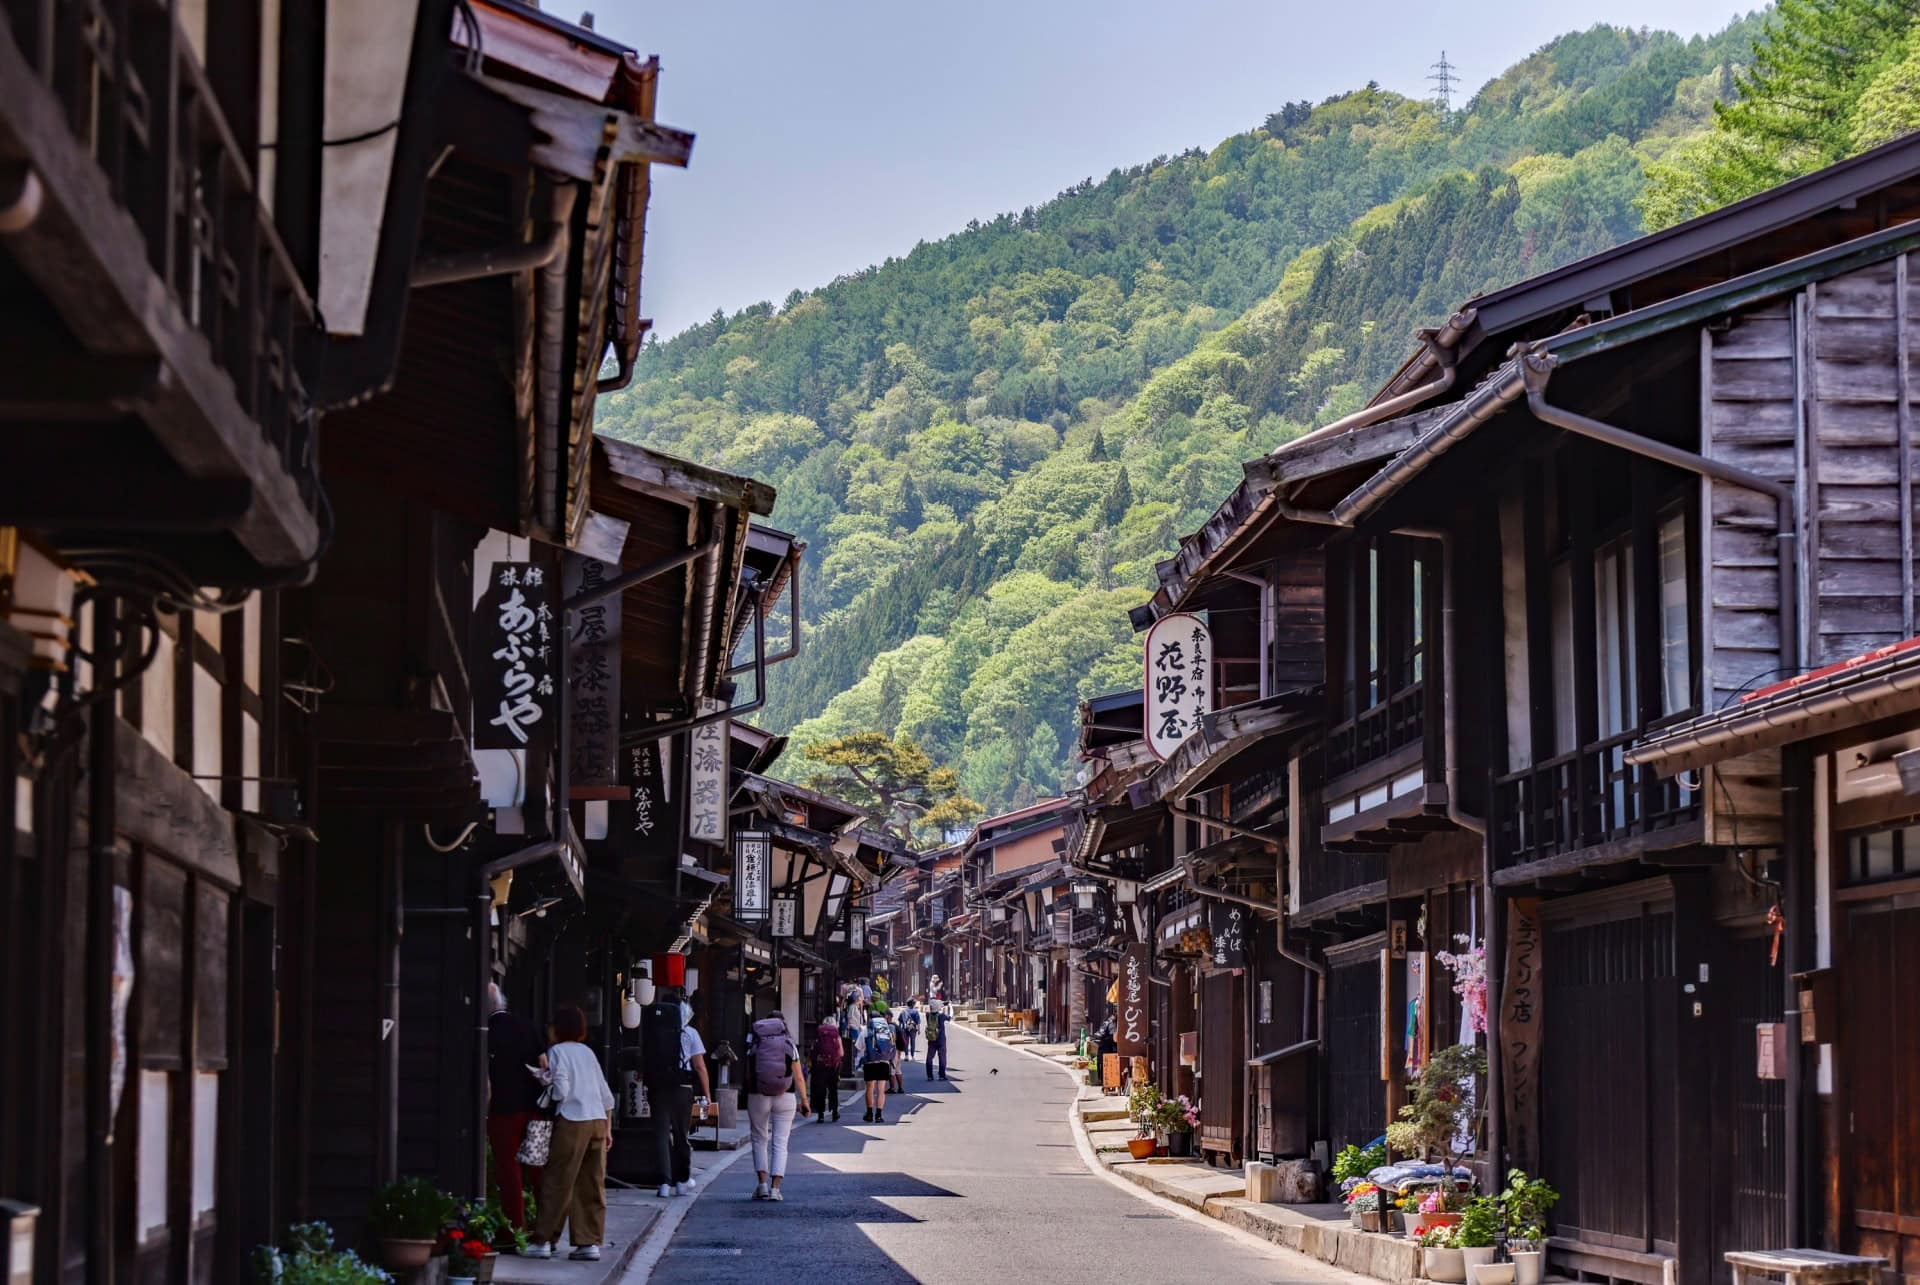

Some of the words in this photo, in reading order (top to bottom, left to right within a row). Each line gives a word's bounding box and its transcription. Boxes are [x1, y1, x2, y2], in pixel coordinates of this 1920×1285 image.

[499, 566, 544, 586] 旅館
[490, 588, 543, 744] あぶらや
[1190, 627, 1207, 681] 奈良井宿
[1155, 641, 1187, 739] 花野屋
[634, 786, 655, 836] ながとや
[1511, 917, 1537, 1024] 手づくりの店
[1511, 1042, 1528, 1110] フレンド
